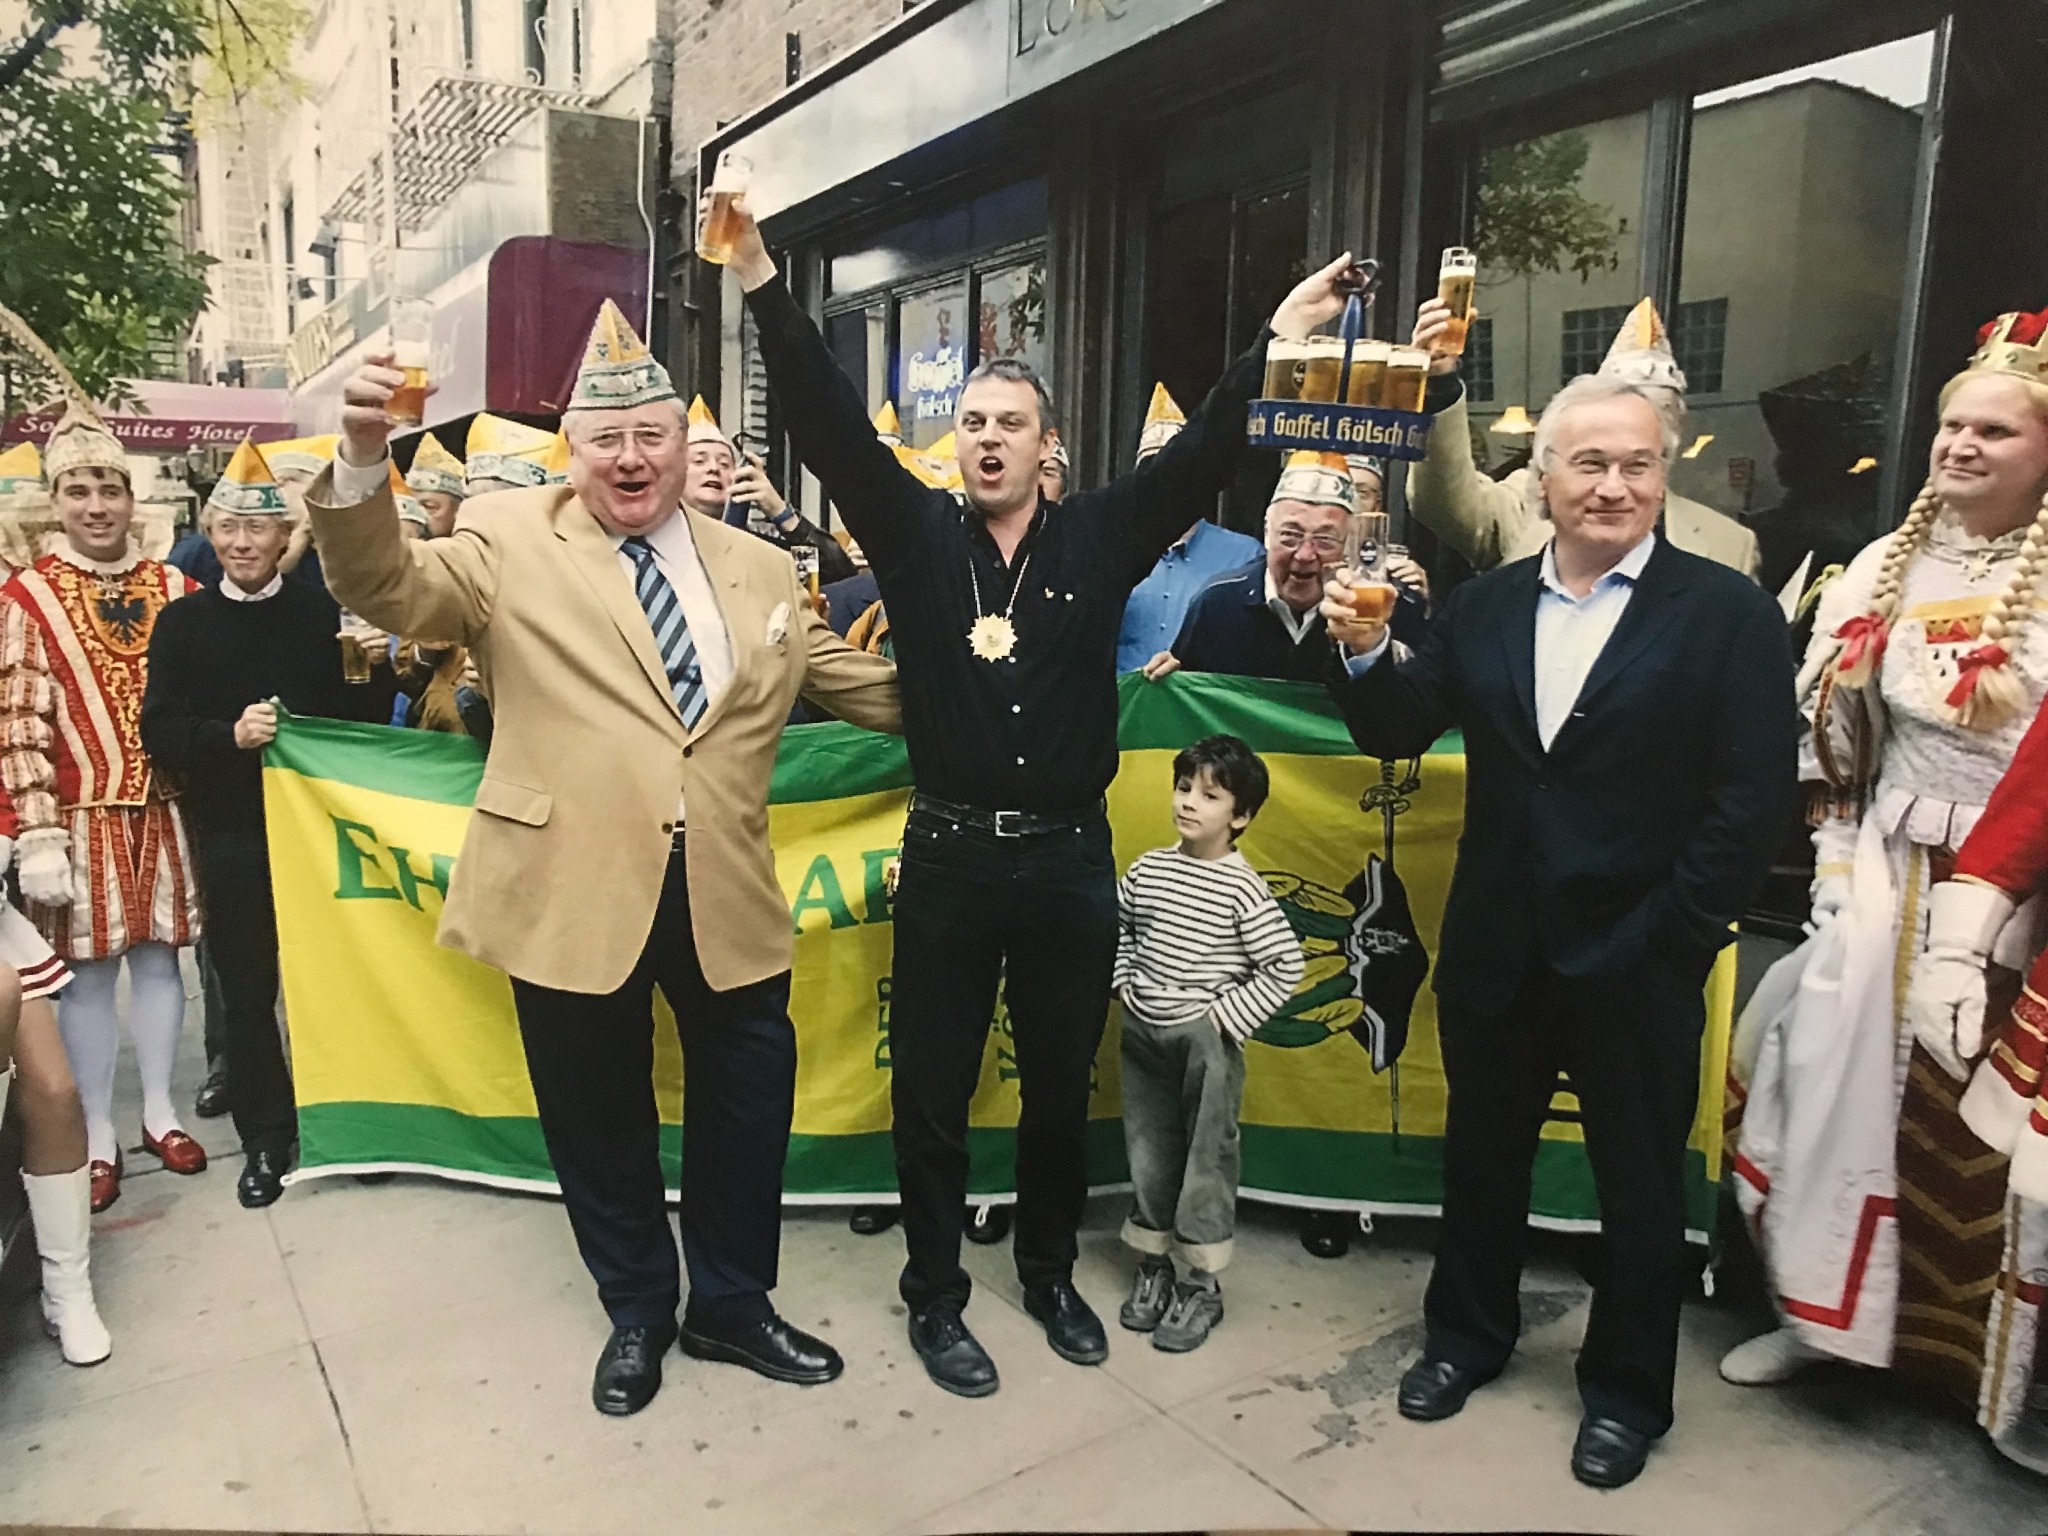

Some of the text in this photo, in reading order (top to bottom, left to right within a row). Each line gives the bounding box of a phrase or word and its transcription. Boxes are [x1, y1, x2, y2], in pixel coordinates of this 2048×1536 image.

[187, 423, 258, 440] Hotel
[1273, 411, 1331, 440] Gaffel
[1335, 416, 1403, 447] Kölsch
